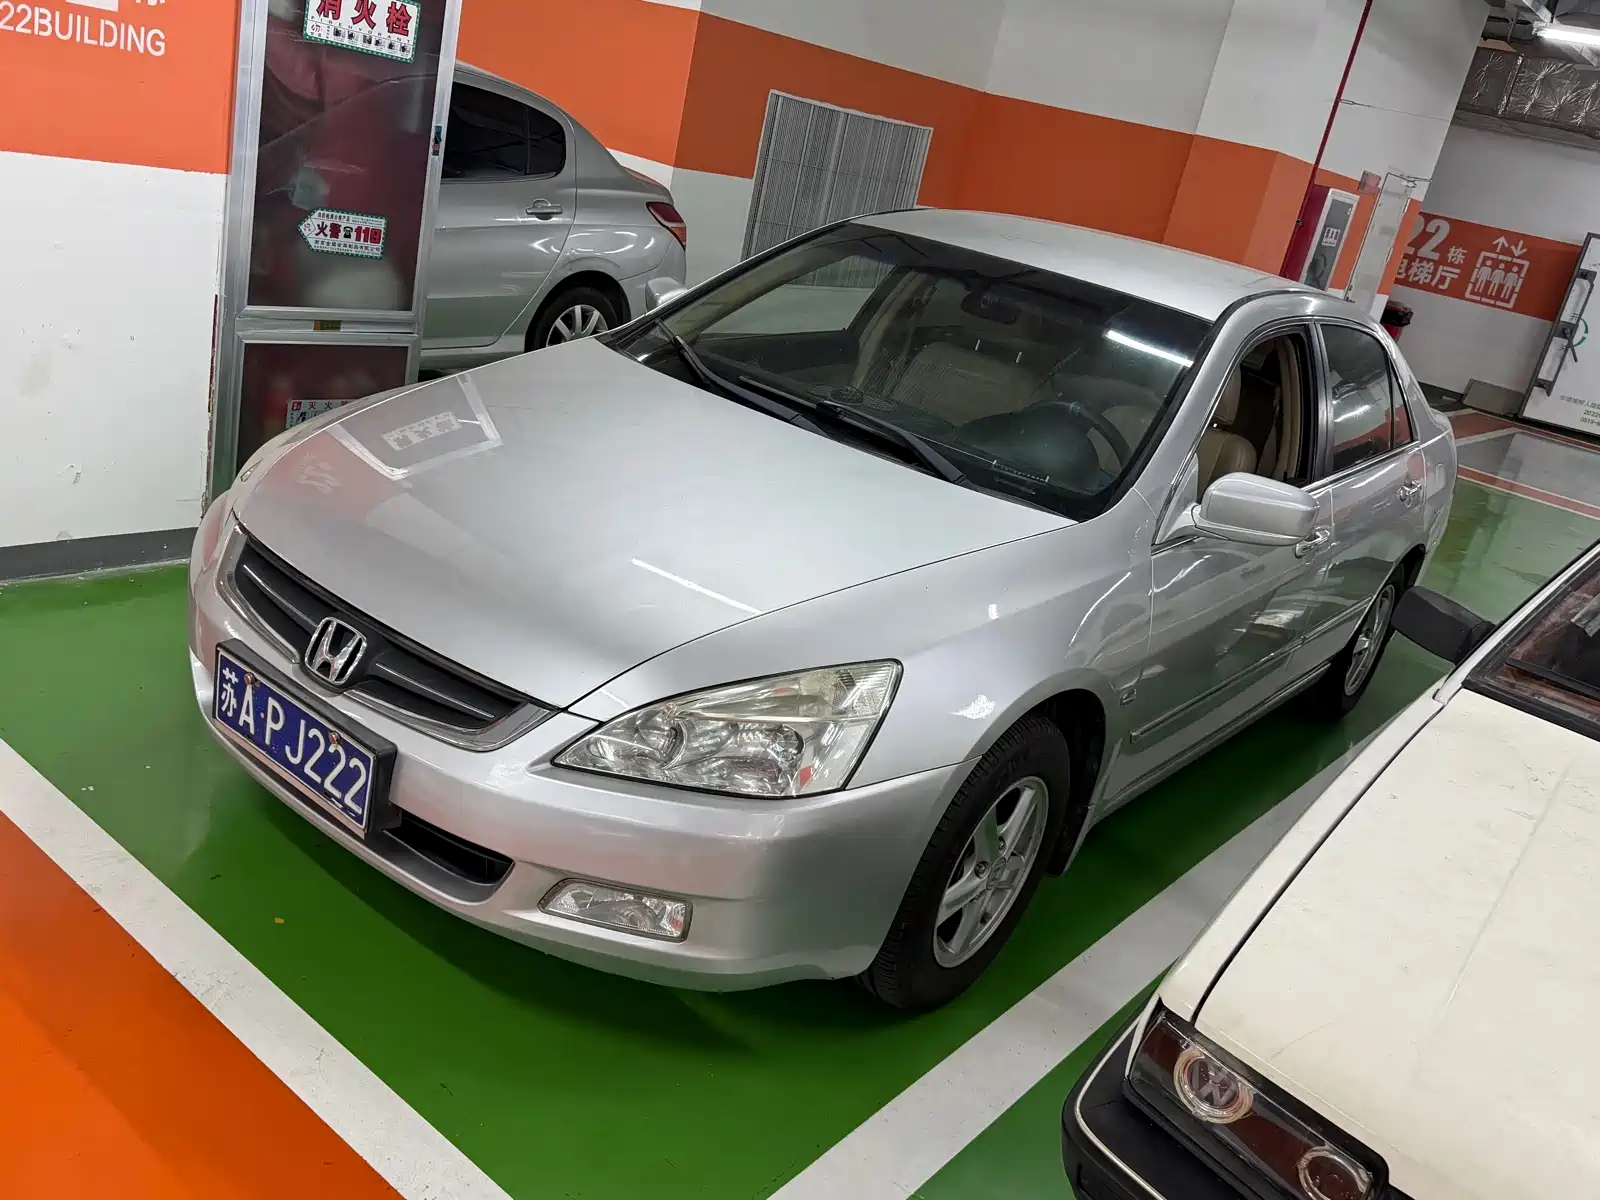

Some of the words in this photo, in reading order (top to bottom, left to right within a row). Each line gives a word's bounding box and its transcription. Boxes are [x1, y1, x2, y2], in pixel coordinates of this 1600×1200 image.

[0, 1, 166, 57] 22BUILDING
[316, 0, 412, 37] 消火栓
[315, 221, 342, 239] 火警
[354, 226, 382, 244] 119
[1447, 245, 1468, 265] 栋
